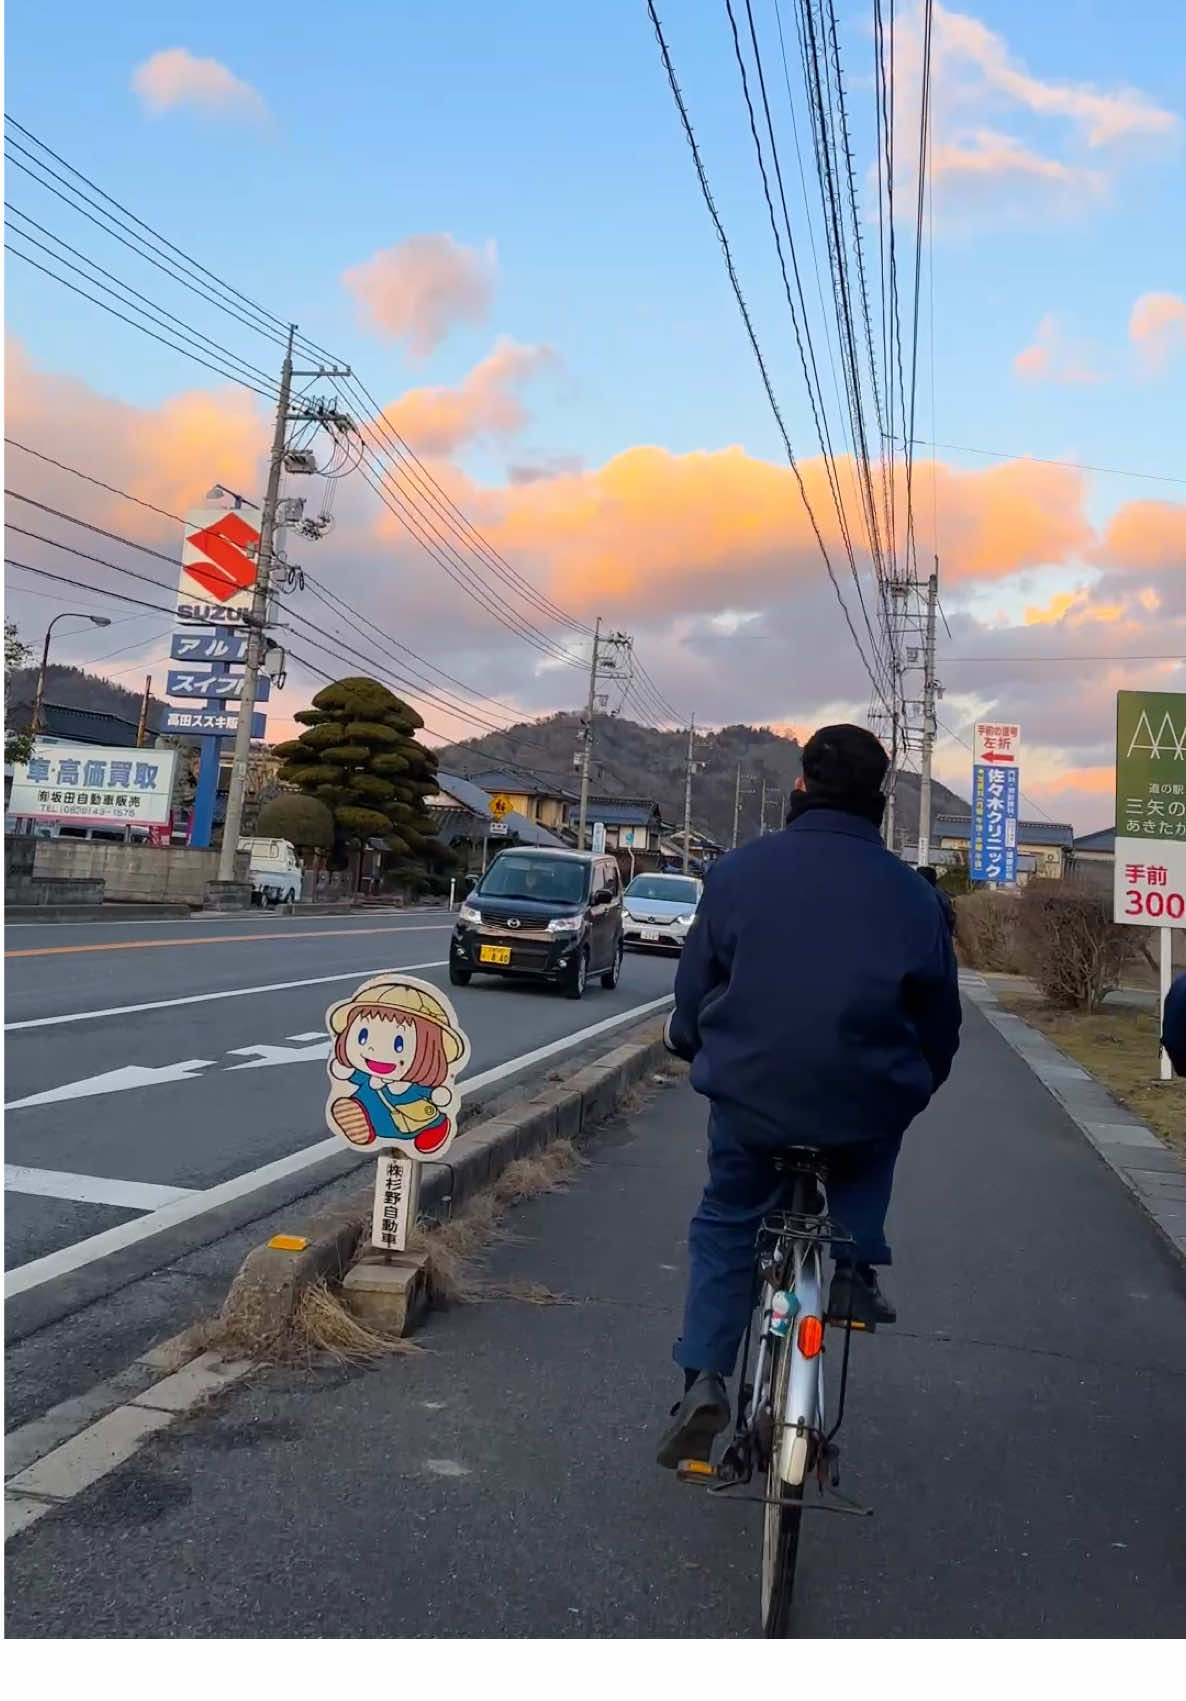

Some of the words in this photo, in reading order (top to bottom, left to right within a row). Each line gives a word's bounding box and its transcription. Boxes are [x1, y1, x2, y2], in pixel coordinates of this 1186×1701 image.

[177, 604, 249, 620] SUZU
[167, 712, 239, 729] 高田スズキ販
[984, 736, 1011, 750] 左折
[1125, 798, 1186, 817] 三矢の
[985, 768, 1006, 878] 佐々木クリニック
[1125, 864, 1169, 886] 手前
[1125, 890, 1185, 918] 300
